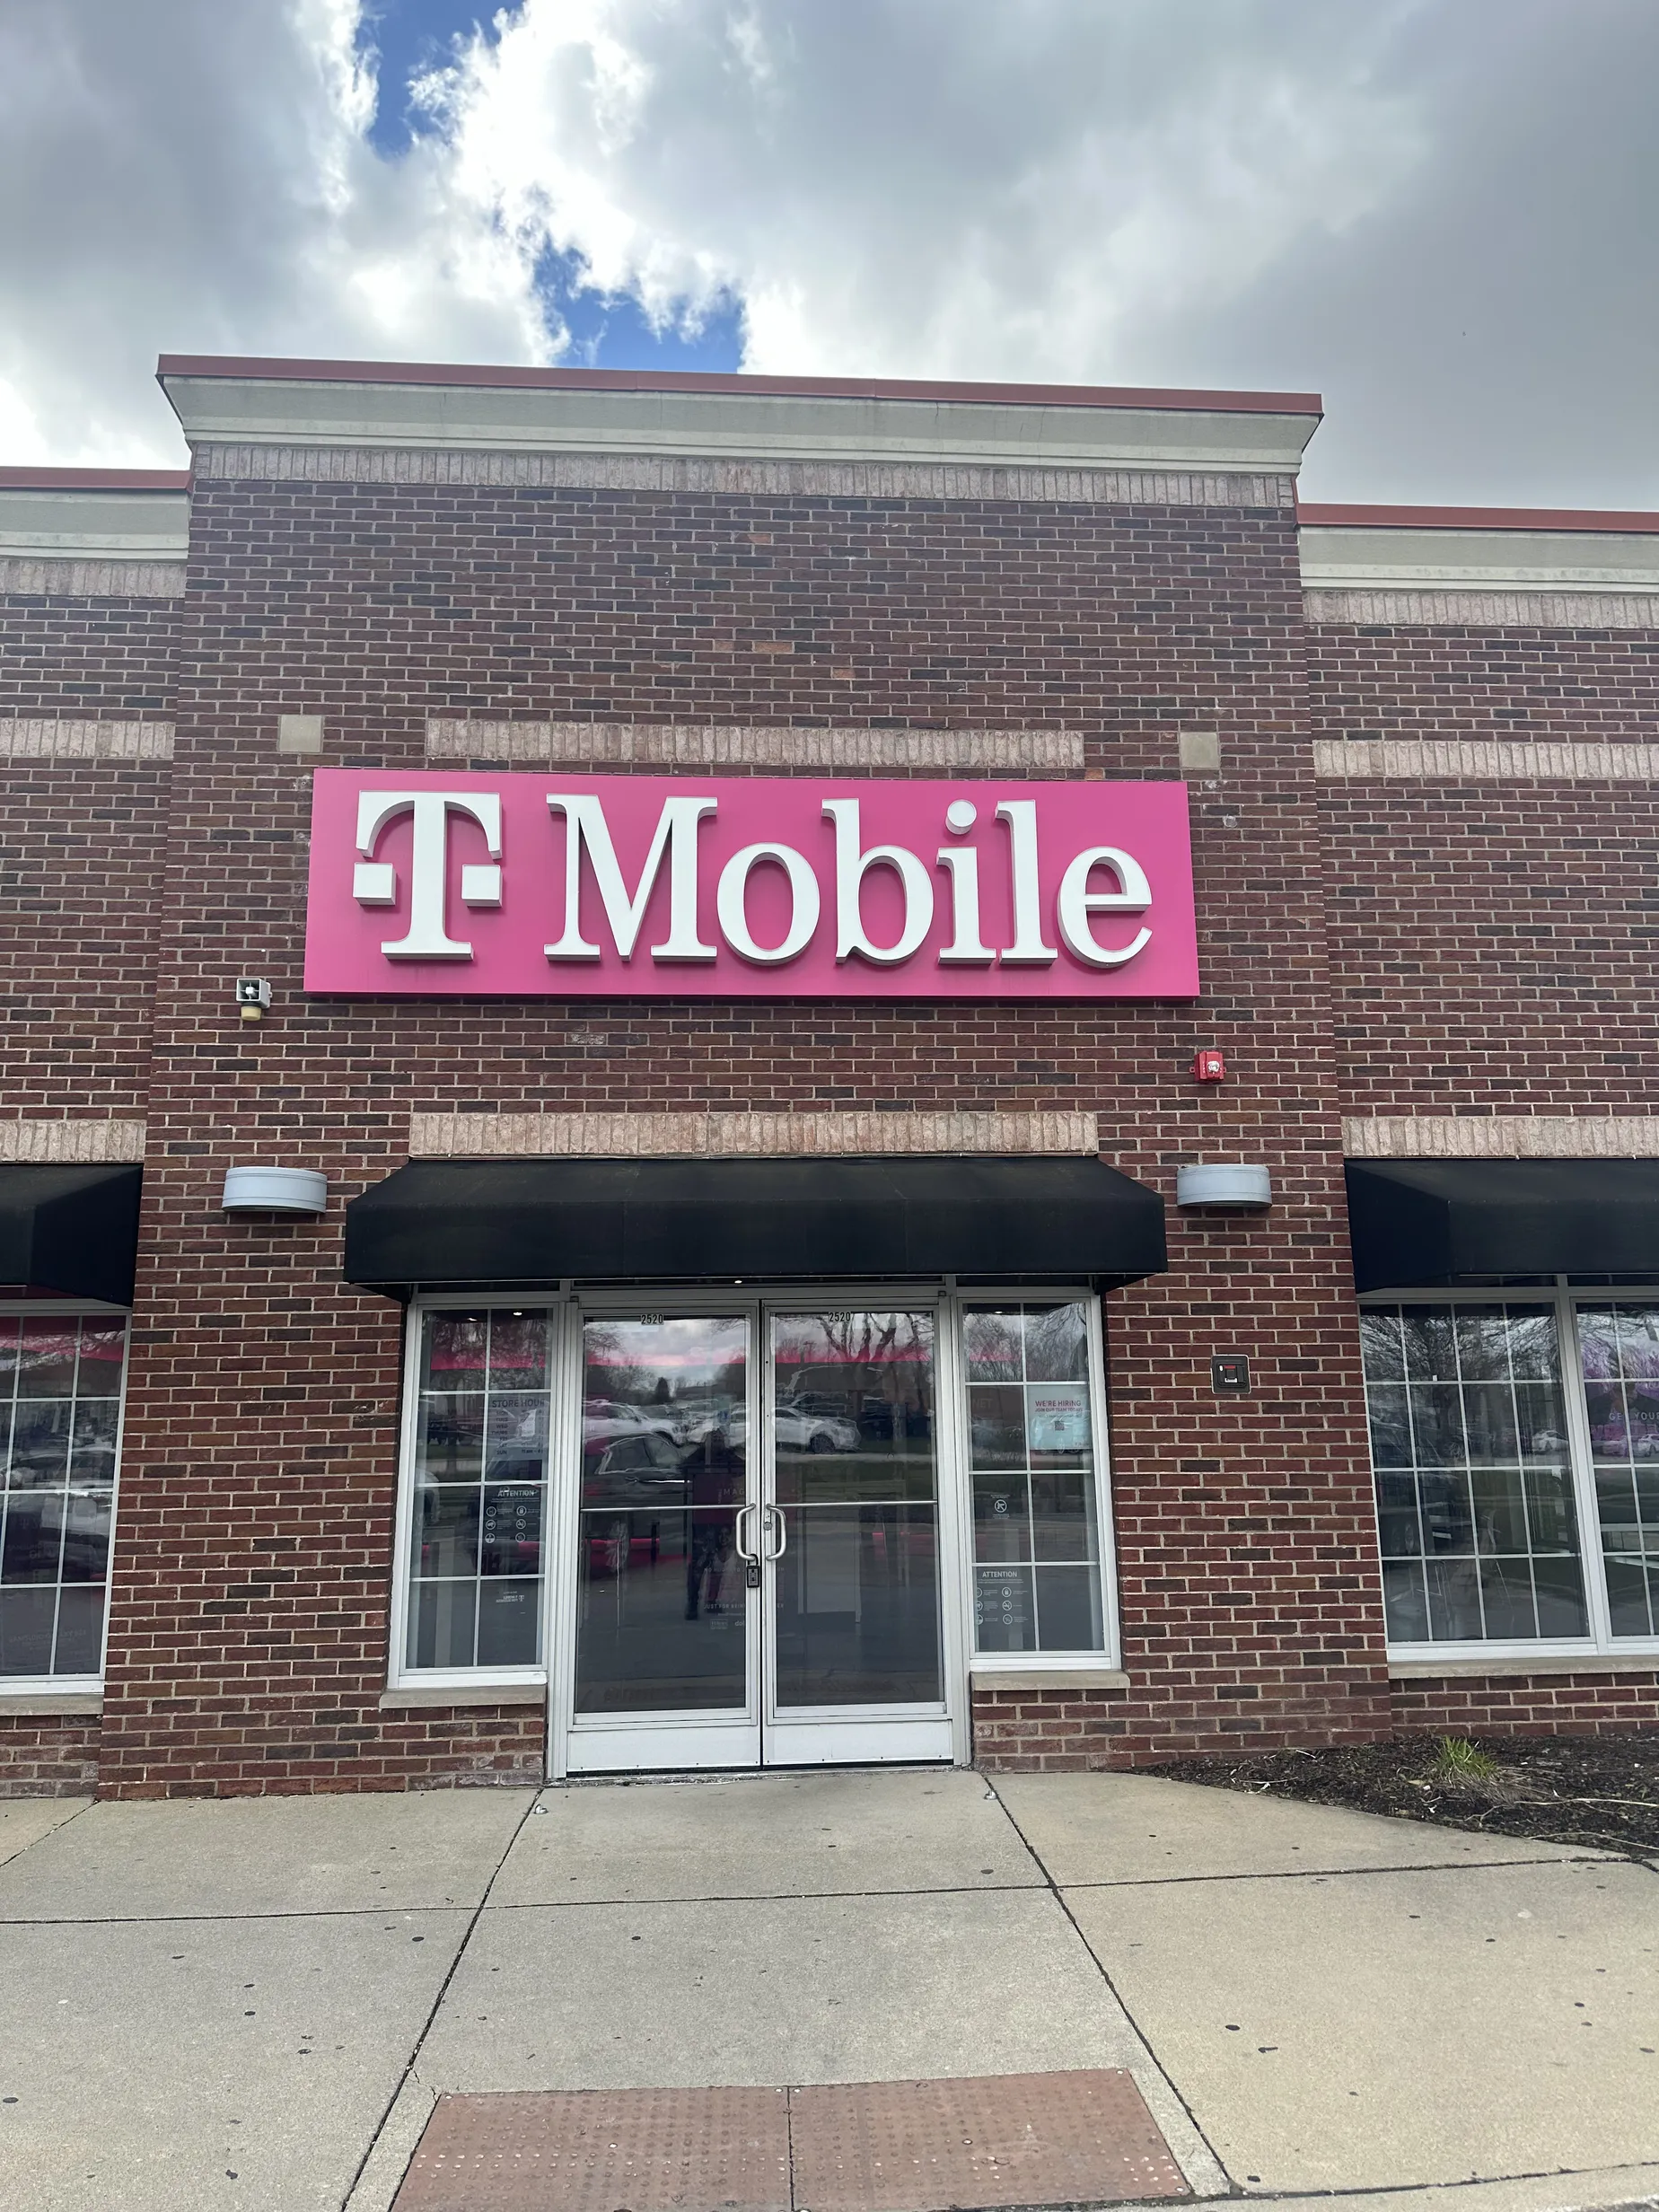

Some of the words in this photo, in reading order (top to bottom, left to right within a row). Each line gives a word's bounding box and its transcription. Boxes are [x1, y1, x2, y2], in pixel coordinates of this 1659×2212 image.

[354, 790, 504, 961] T
[544, 793, 1154, 969] Mobile
[641, 1314, 663, 1324] 2520
[829, 1312, 851, 1322] 2520
[492, 1400, 519, 1408] STORE
[1609, 1412, 1622, 1420] GE
[497, 1489, 535, 1497] ATTENTION
